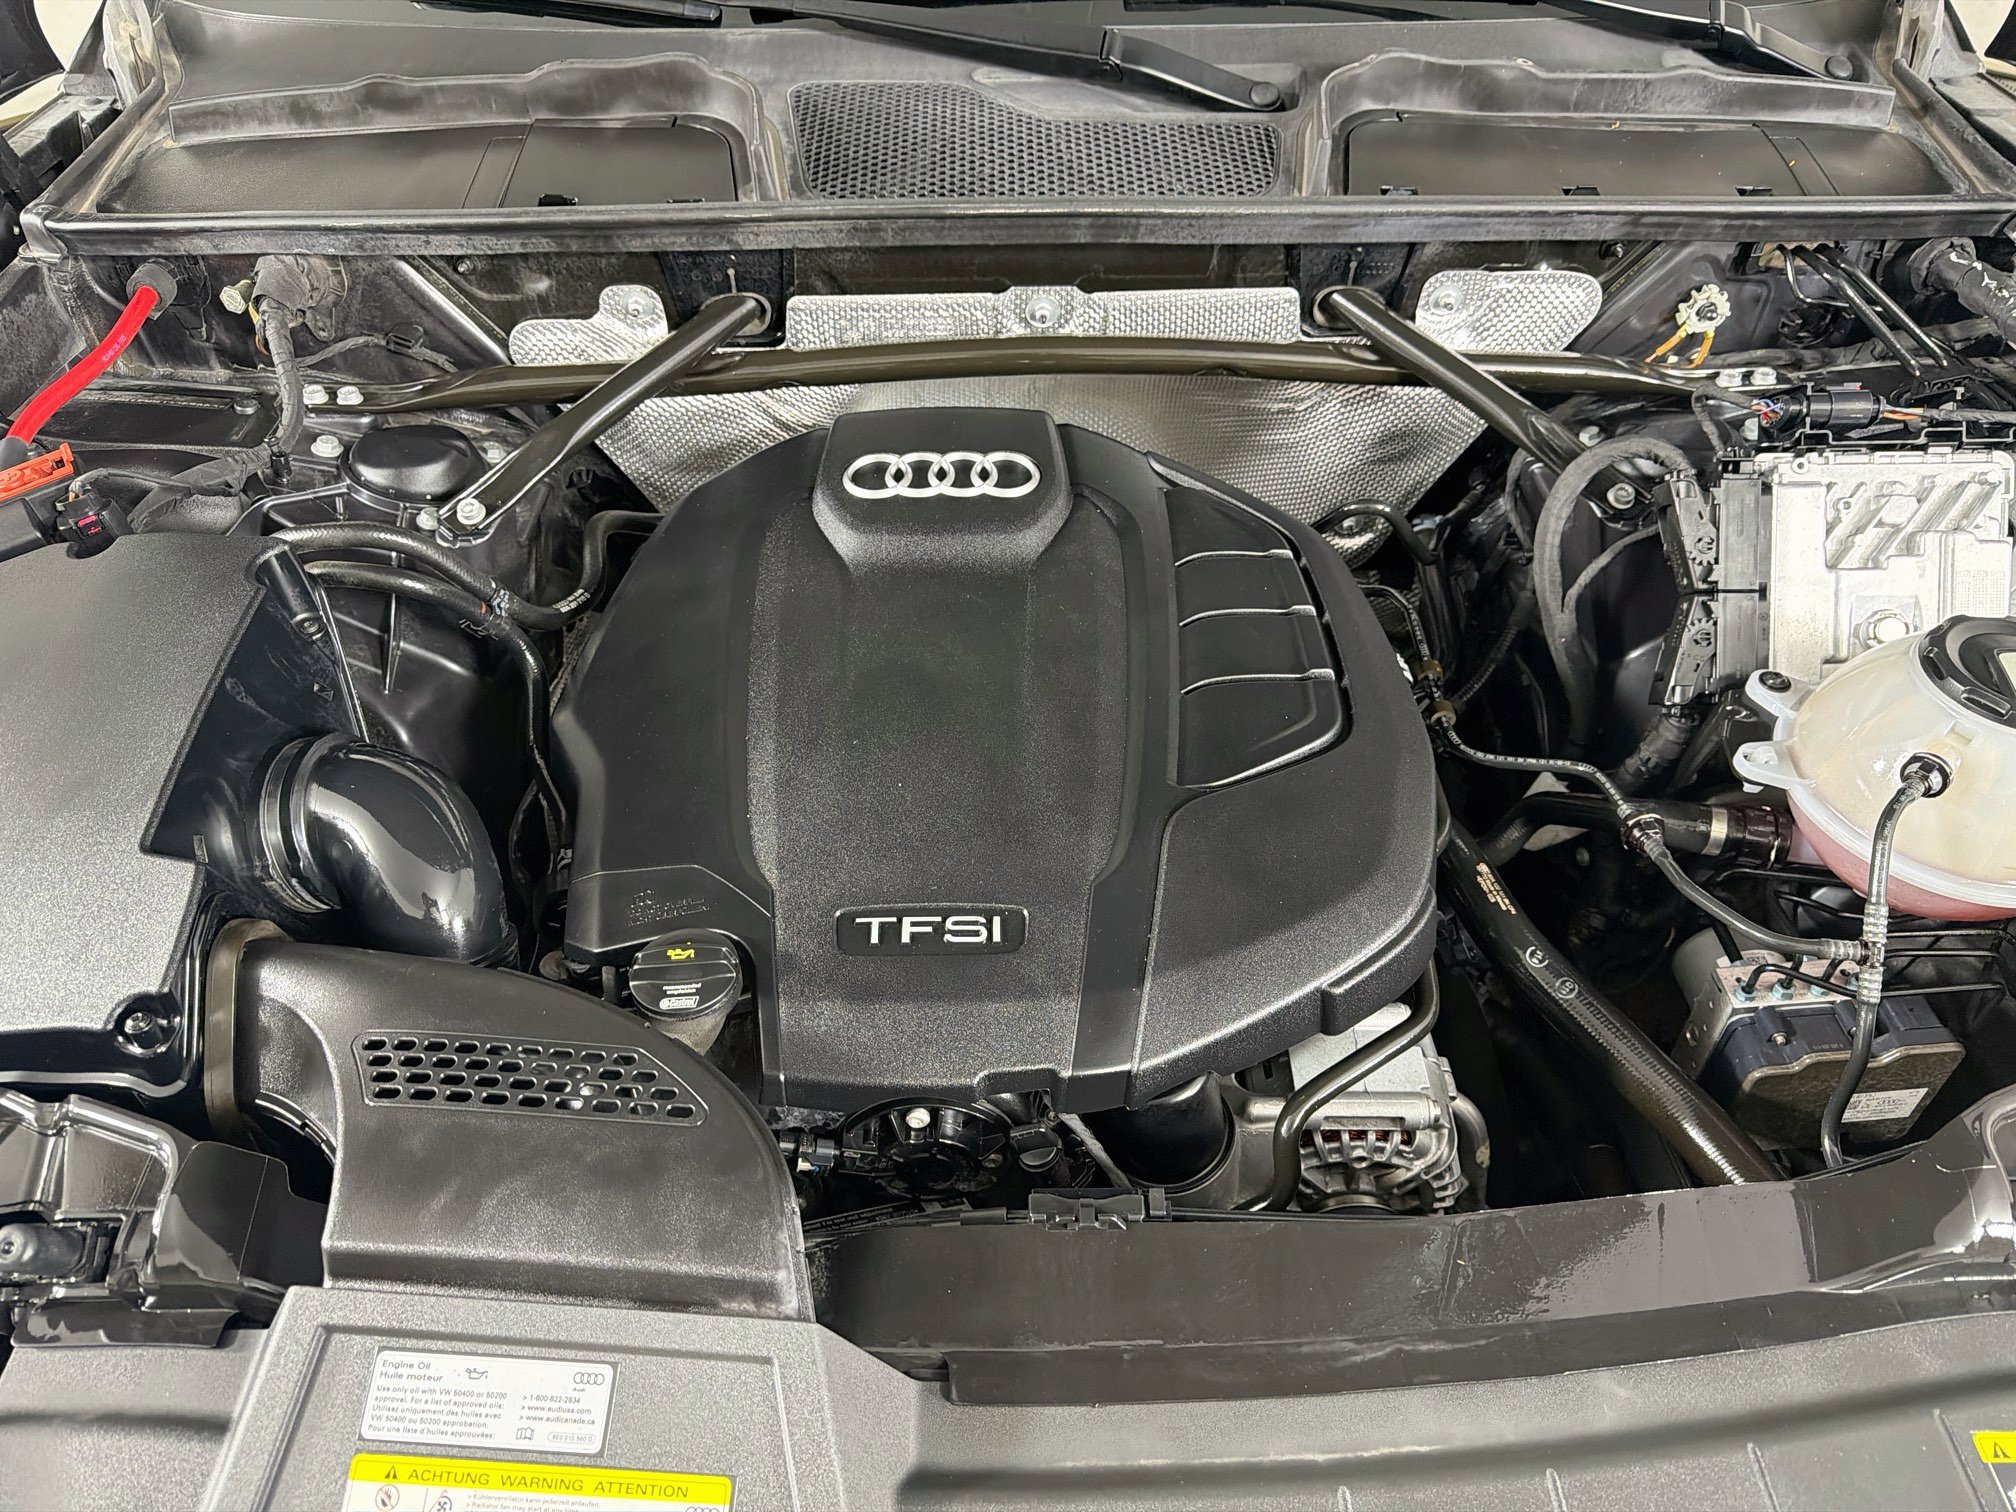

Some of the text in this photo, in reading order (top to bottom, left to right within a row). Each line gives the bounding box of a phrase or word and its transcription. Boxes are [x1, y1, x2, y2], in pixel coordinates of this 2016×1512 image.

[854, 915, 1001, 944] TFSI
[382, 1360, 431, 1370] Engine Oil
[380, 1370, 443, 1382] Huile moteur
[377, 1384, 391, 1392] Use
[392, 1385, 409, 1394] only
[410, 1386, 420, 1394] oil
[421, 1387, 437, 1395] with
[439, 1388, 453, 1396] VW
[411, 1396, 422, 1404] For
[453, 1400, 488, 1409] approved
[372, 1404, 399, 1413] Utilisez
[400, 1407, 445, 1416] uniquement
[445, 1408, 459, 1416] des
[527, 1405, 592, 1415] www.audiusa.com
[371, 1413, 383, 1421] VW
[525, 1415, 596, 1425] www.audicanada.ca
[367, 1423, 385, 1432] Pour
[402, 1425, 418, 1434] liste
[408, 1469, 689, 1498] ACHTUNG WARNING ATTENTION
[471, 1501, 499, 1509] Radiator
